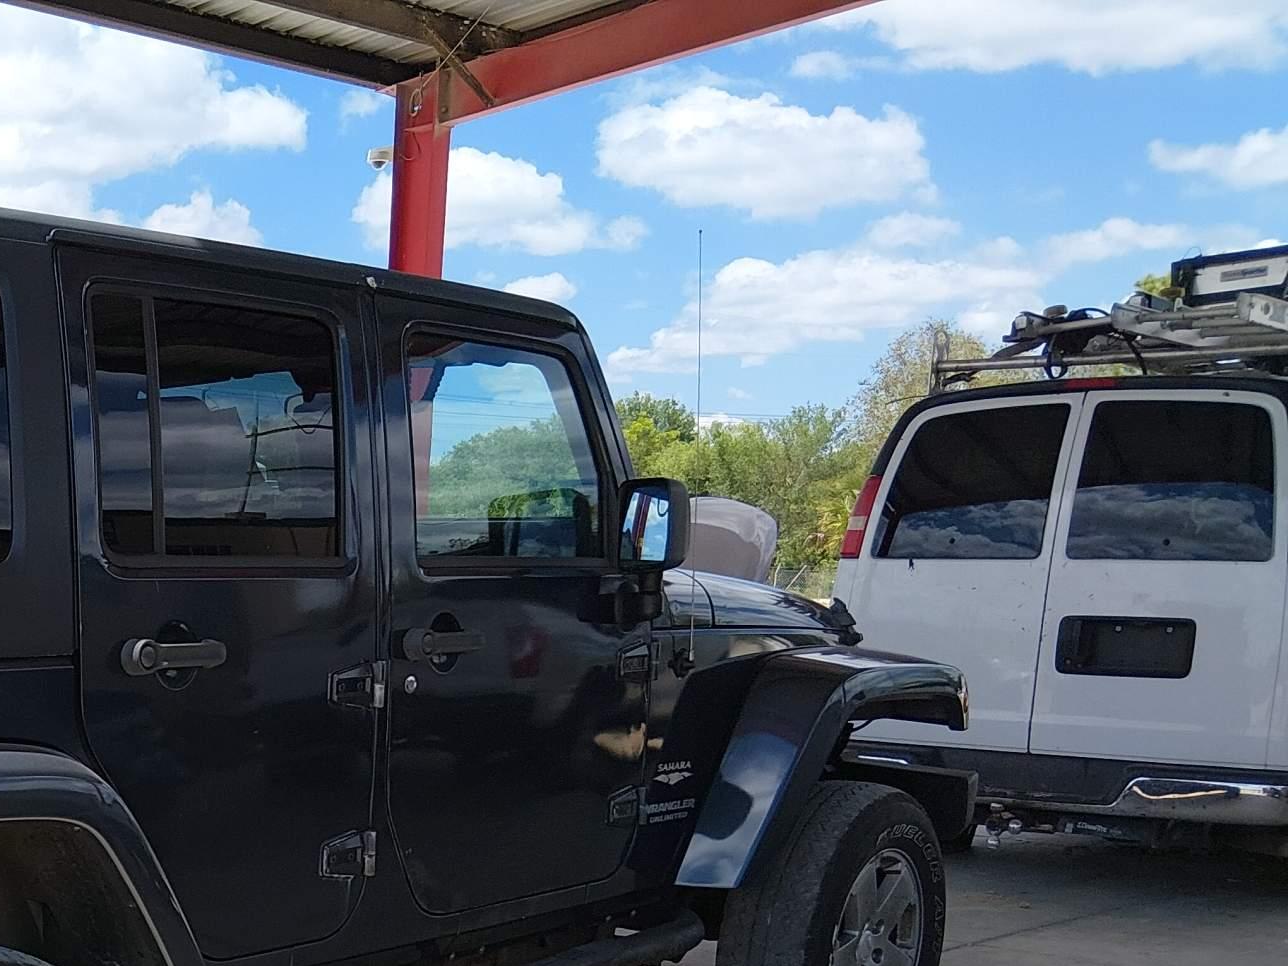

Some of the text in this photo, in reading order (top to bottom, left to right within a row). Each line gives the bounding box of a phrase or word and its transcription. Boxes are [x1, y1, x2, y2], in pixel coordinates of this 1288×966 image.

[657, 761, 692, 772] SAHARA
[640, 798, 695, 814] WRANGLER
[649, 812, 688, 823] UNLIMITED
